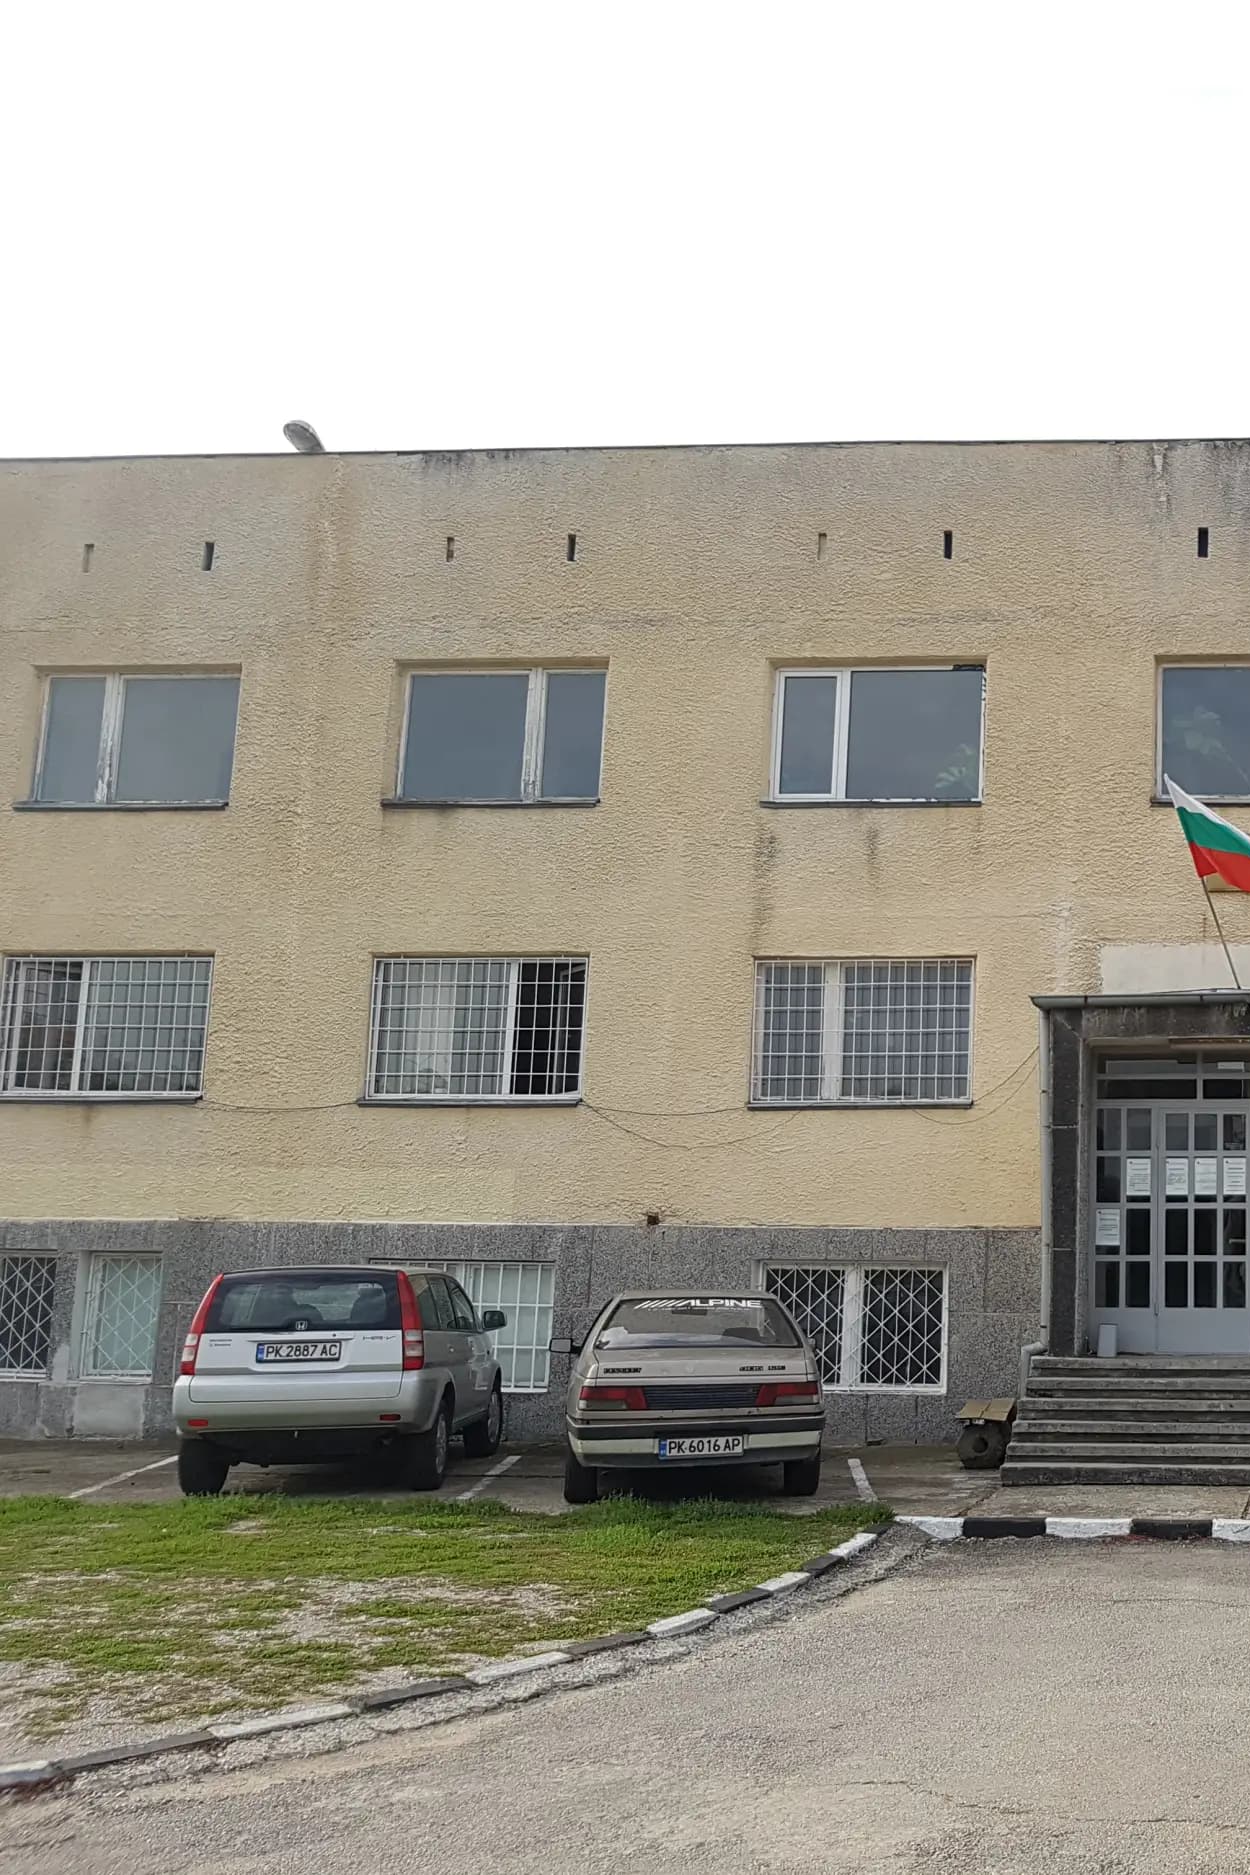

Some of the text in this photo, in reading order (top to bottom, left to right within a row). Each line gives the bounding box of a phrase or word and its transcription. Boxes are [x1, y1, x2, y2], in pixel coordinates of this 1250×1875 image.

[674, 1299, 763, 1309] ALPINE
[265, 1344, 338, 1358] PK 2887 AC
[668, 1438, 741, 1454] PK 6016 AP
